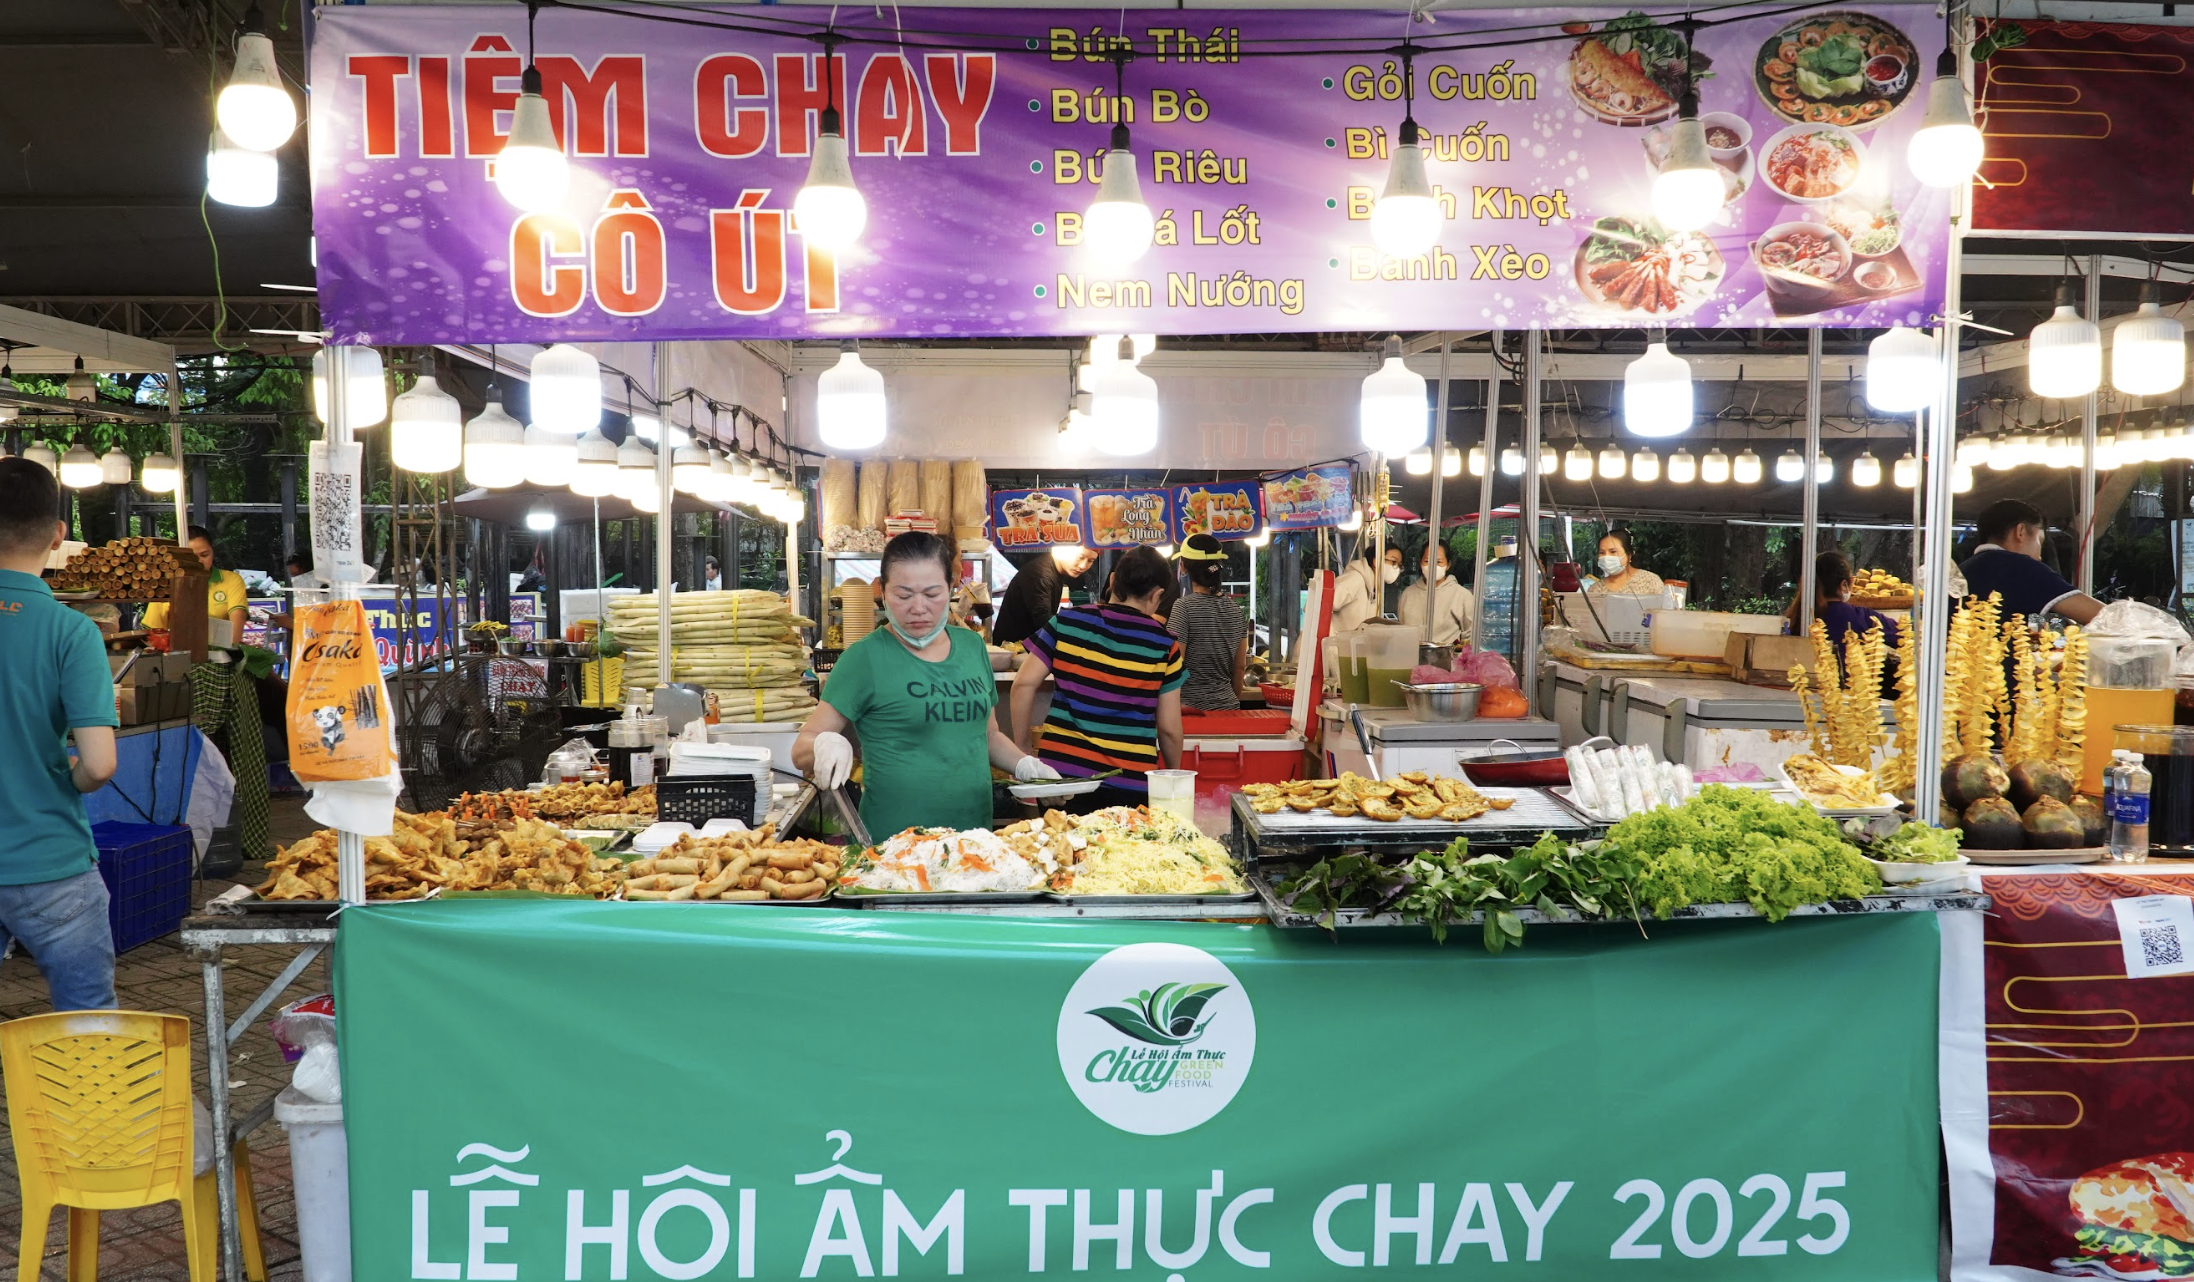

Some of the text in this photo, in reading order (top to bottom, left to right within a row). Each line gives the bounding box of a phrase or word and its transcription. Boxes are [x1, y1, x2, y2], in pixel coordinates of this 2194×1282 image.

[1050, 27, 1240, 64] Bún Thái
[1428, 60, 1537, 101] Cuốn
[345, 32, 997, 182] TIỆM CHAY
[1051, 87, 1210, 124] Bún Bò
[1345, 126, 1389, 160] Bì
[1053, 149, 1248, 185] Bú Riêu
[1347, 185, 1571, 227] Bh Khọt
[1193, 204, 1261, 246] Lốt
[509, 188, 668, 318] CÔ
[1470, 244, 1551, 281] Xèo
[1056, 270, 1305, 316] Nem Nướng
[1121, 509, 1151, 526] Long
[906, 676, 988, 698] CALVIN
[925, 698, 988, 722] KLEIN
[1085, 1046, 1180, 1093] Chay
[1148, 1049, 1170, 1062] Hội
[1196, 1049, 1226, 1062] Thực
[1180, 1060, 1224, 1069] GREEN
[1168, 1080, 1213, 1088] FESTIVAL
[1174, 1070, 1212, 1080] FOOD
[411, 1142, 540, 1281] LỄ
[794, 1129, 966, 1279] ẨM
[1008, 1169, 1274, 1282] THỰC
[1312, 1180, 1575, 1267] CHAY
[1610, 1170, 1851, 1262] 2025
